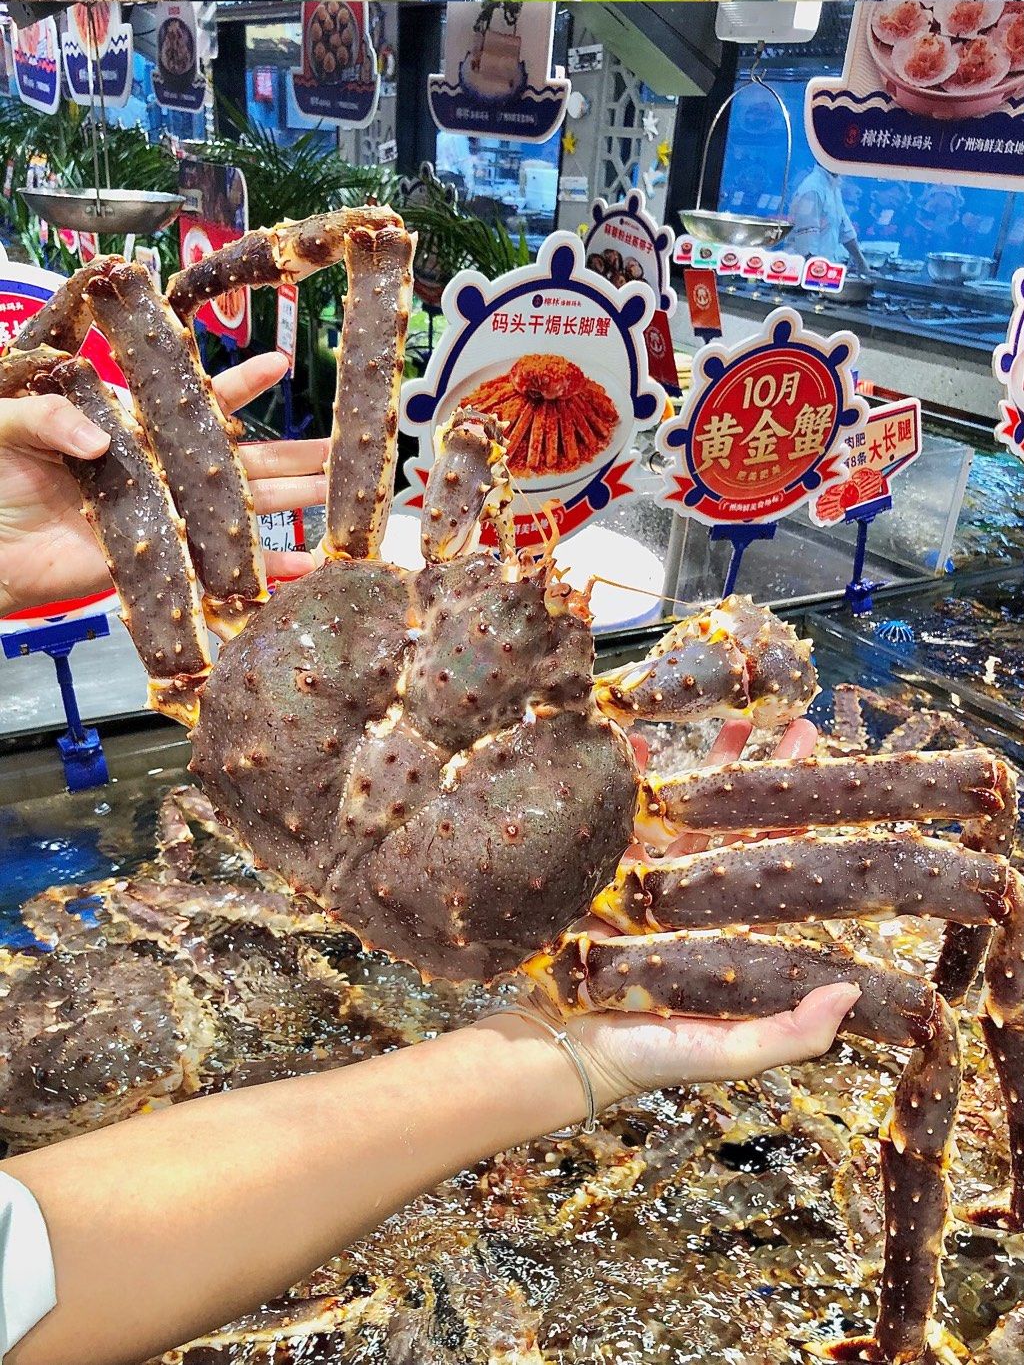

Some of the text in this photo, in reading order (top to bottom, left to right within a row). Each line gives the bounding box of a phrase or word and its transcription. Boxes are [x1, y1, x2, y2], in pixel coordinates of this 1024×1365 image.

[890, 134, 933, 151] 海鲜码头
[491, 312, 612, 337] 码头干焗长脚蟹
[742, 370, 801, 410] 10月
[694, 402, 835, 476] 黄金蟹
[868, 418, 912, 464] 大长腿
